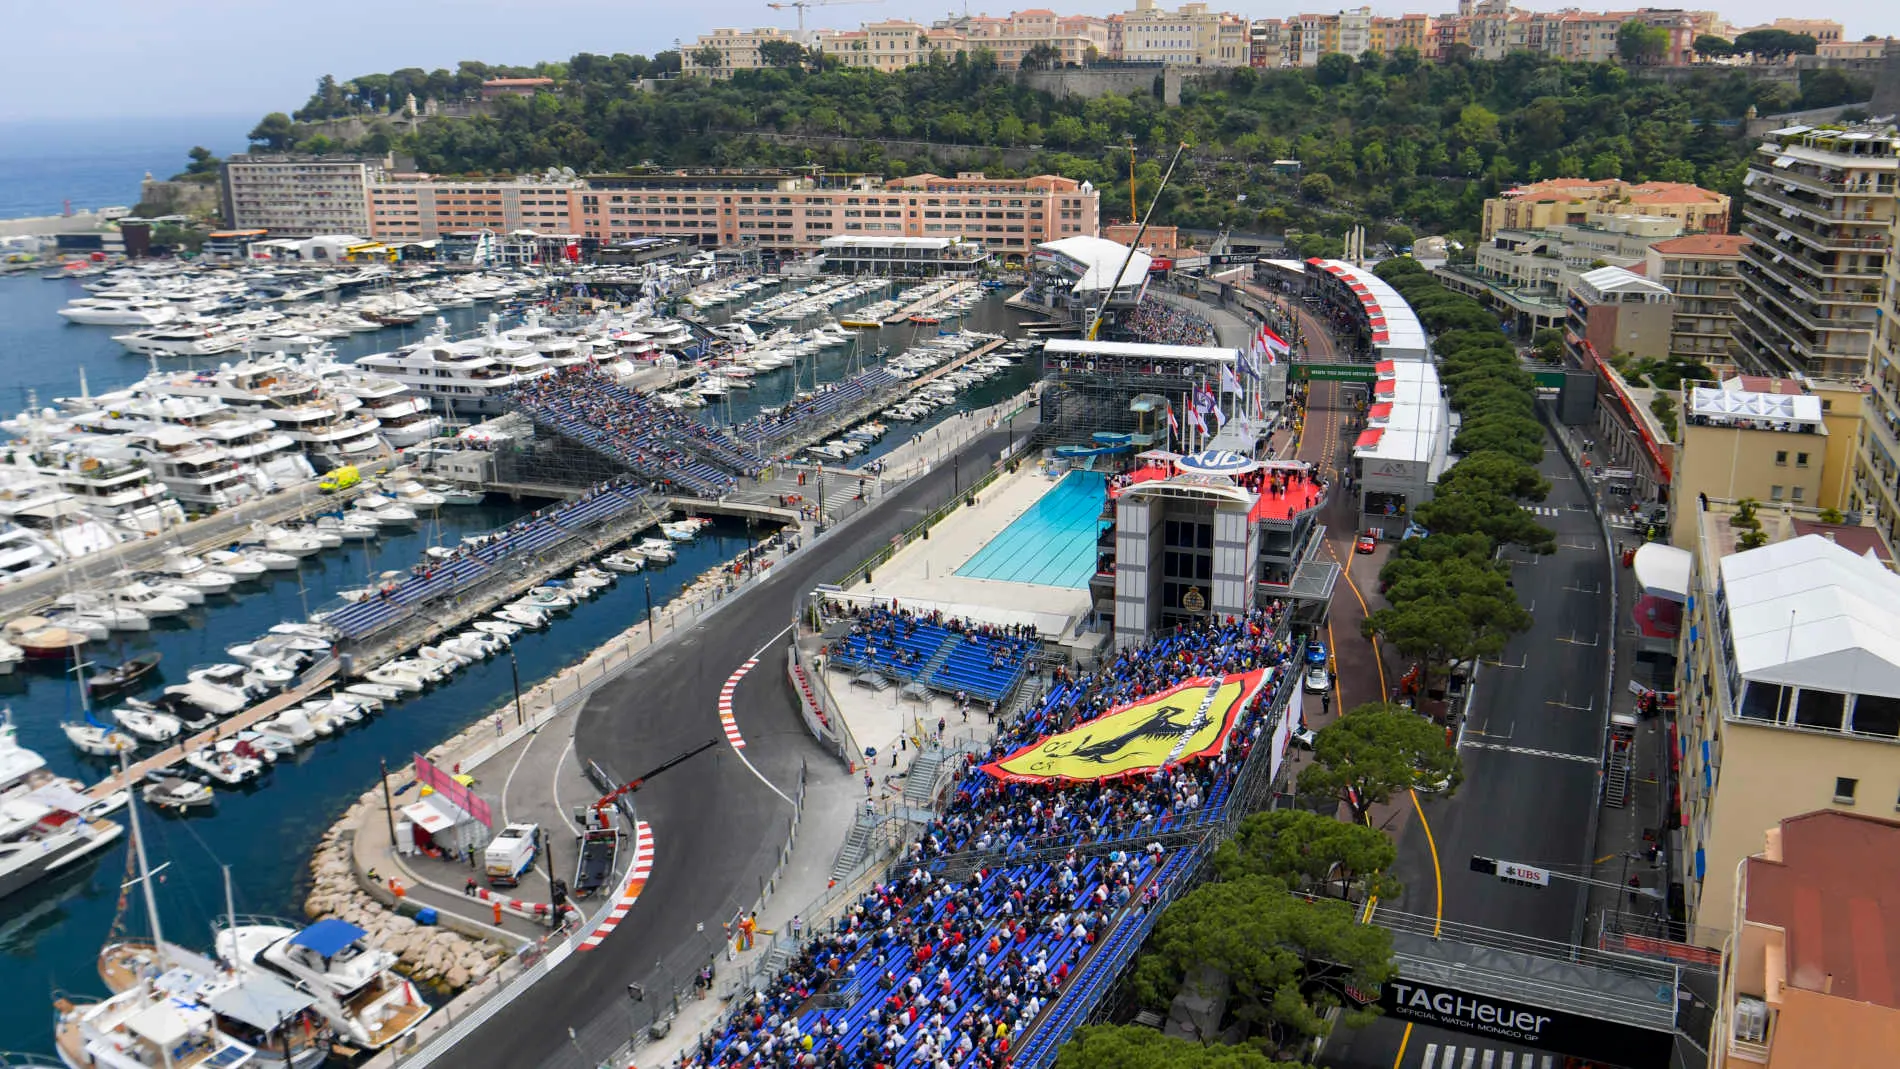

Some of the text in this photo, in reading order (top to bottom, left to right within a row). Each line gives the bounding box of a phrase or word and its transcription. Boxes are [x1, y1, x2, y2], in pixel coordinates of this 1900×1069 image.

[1517, 868, 1541, 880] UBS
[1396, 1006, 1539, 1041] OFFICIAL WATCH MONACO GP
